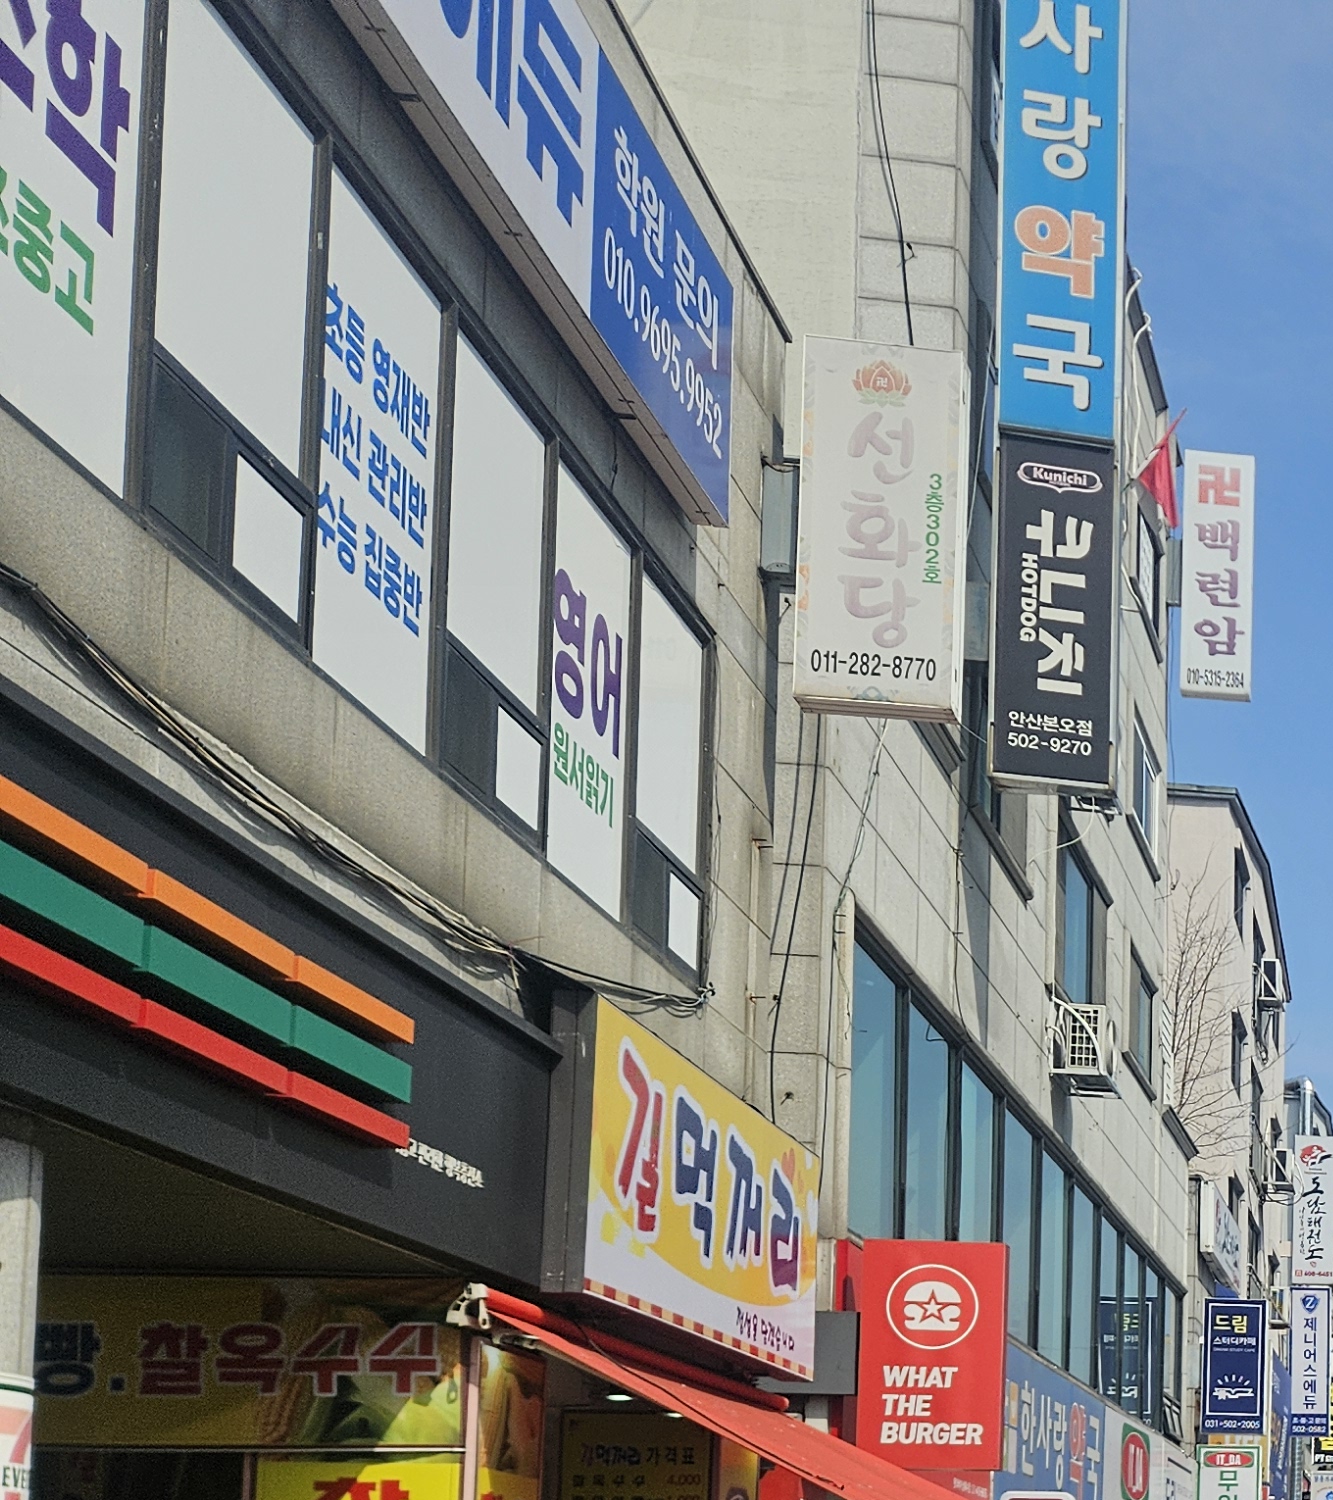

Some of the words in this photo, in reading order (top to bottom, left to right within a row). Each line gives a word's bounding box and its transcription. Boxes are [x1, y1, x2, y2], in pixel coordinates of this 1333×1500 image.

[614, 126, 665, 279] 학원
[674, 229, 719, 369] 문의
[1012, 0, 1105, 411] 사랑약국
[604, 227, 723, 459] 010.9695.9952
[372, 338, 430, 459] 영재반
[368, 430, 428, 549] 관리반
[1033, 467, 1087, 486] Kunichi
[317, 480, 358, 575] 수능
[364, 524, 423, 637] 집중반
[1019, 552, 1038, 642] HOTDOG
[1025, 509, 1094, 695] 쿠니치
[1194, 519, 1245, 656] 백련암
[553, 568, 623, 759] 영어
[811, 649, 936, 681] 011-282-8770
[1007, 732, 1091, 756] 502-9270
[1008, 710, 1093, 737] 안산본오점
[553, 721, 614, 829] 원서읽기
[1213, 1315, 1247, 1333] 드림
[1213, 1337, 1256, 1346] 스터디카페
[1303, 1317, 1317, 1410] 제니어스에듀
[882, 1394, 932, 1417] THE
[883, 1366, 958, 1388] WHAT
[880, 1421, 983, 1446] BURGER
